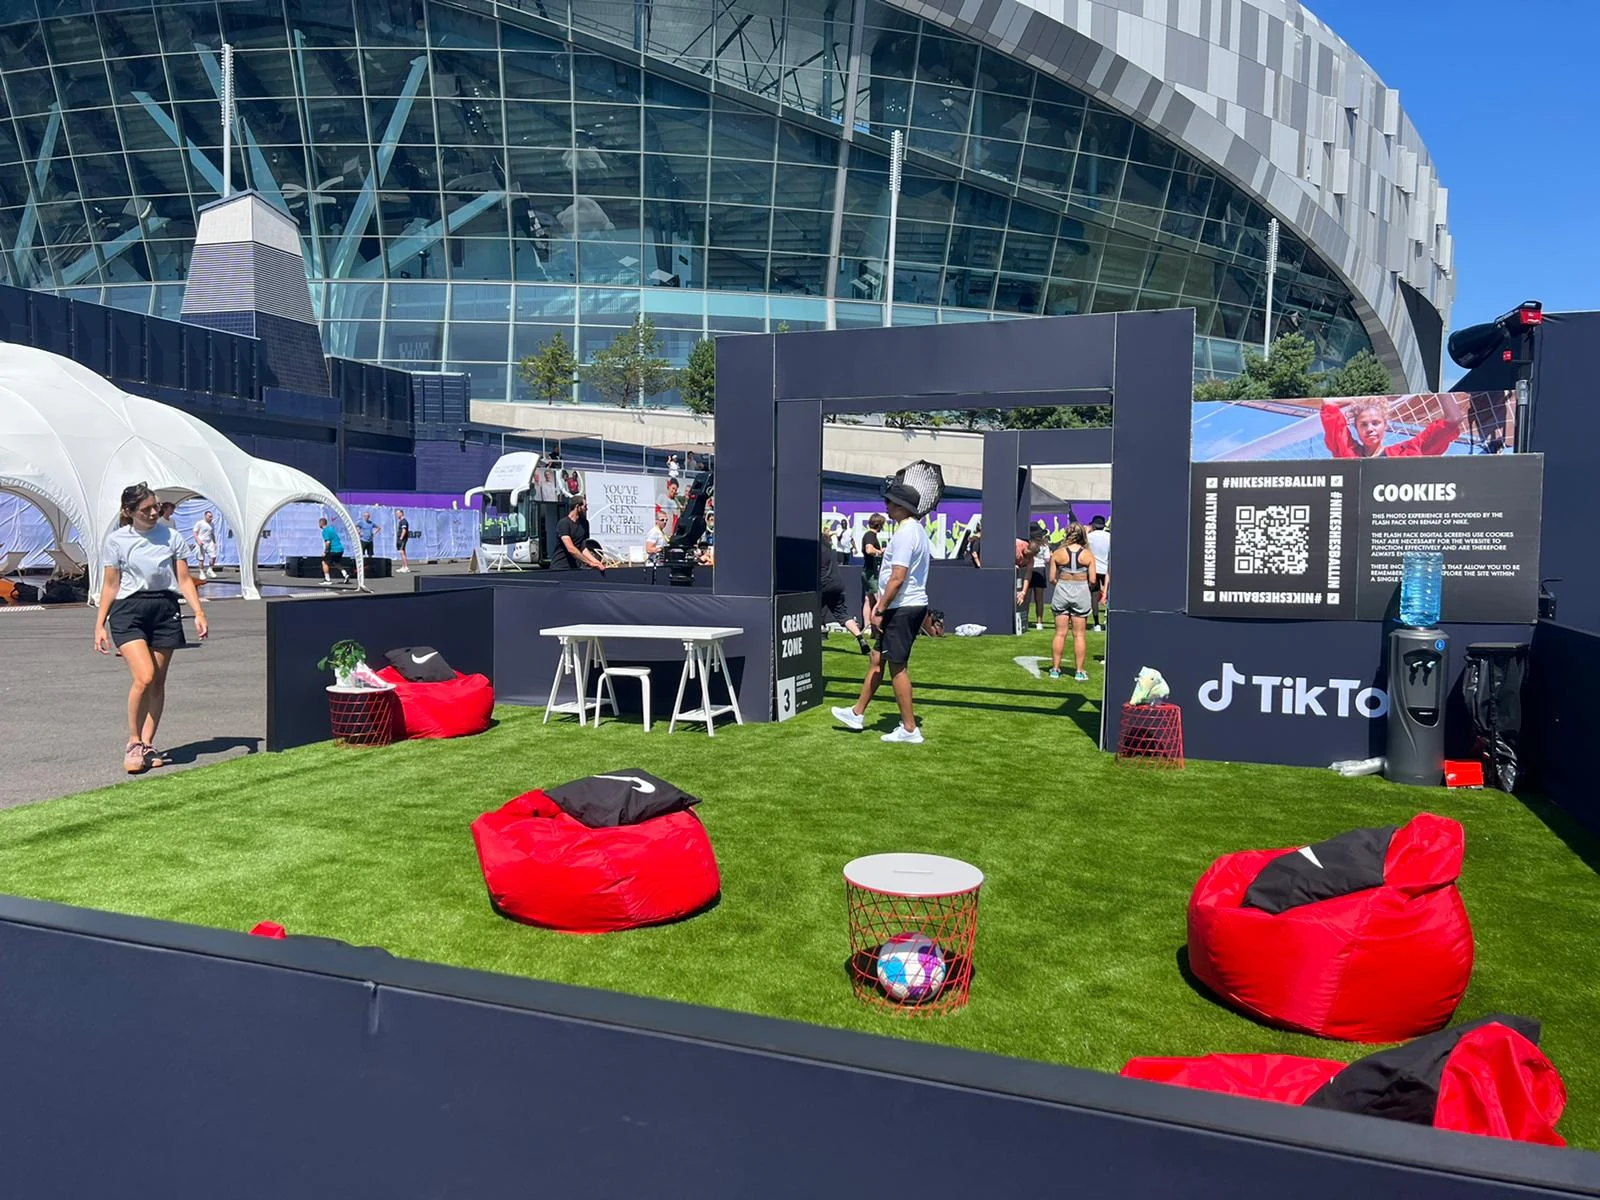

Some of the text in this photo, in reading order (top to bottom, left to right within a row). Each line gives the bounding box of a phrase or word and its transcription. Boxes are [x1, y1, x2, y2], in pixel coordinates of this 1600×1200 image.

[603, 484, 639, 495] YOU'VE
[1222, 475, 1326, 488] #NIKESHESBALLIN
[606, 494, 637, 504] NEVER
[1373, 483, 1456, 502] COOKIES
[610, 504, 633, 514] SEEN
[600, 524, 645, 535] LIKE THIS
[1203, 493, 1218, 587] #NIKESHESBALLIN
[1327, 491, 1343, 589] #NIKESHESBALLIN
[1219, 591, 1322, 604] #NIKESHESBALLIN
[782, 612, 814, 634] CREATOR
[782, 637, 802, 658] ZONE
[784, 688, 790, 712] 3
[1252, 675, 1388, 718] TikTo
